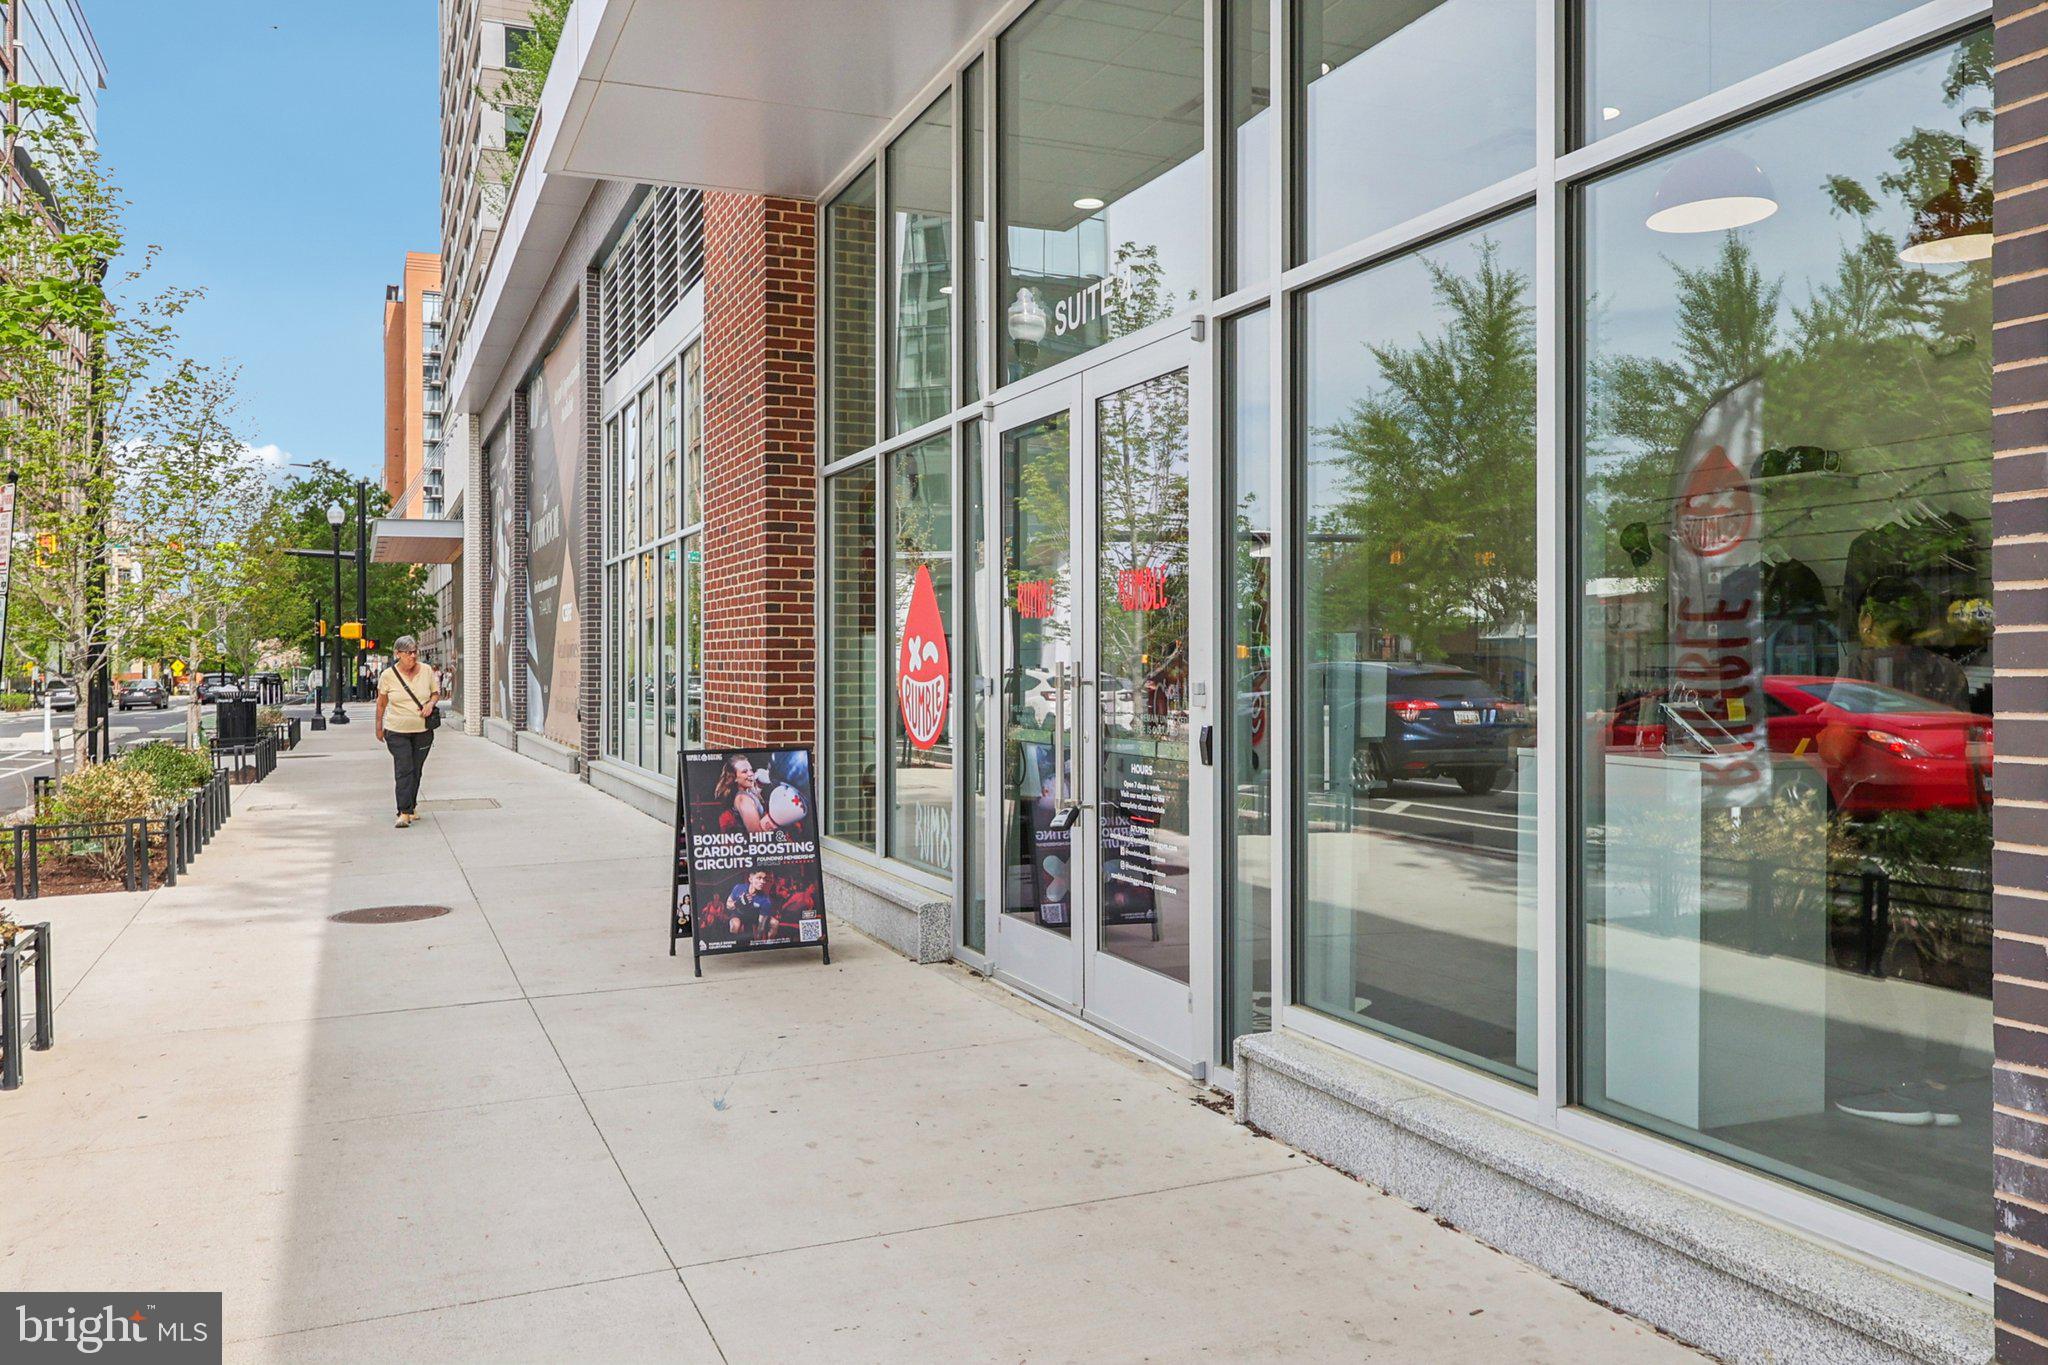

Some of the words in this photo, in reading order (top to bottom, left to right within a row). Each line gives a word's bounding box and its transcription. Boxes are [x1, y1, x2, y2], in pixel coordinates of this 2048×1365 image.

[1054, 275, 1115, 337] SUITE
[1017, 577, 1055, 619] RUMBLE
[1117, 563, 1168, 612] RUMBLE
[905, 680, 942, 737] RUMBLE
[1123, 780, 1134, 789] Open
[1131, 763, 1153, 776] HOURS
[693, 832, 748, 846] BOXING,
[749, 831, 774, 843] HIIT
[775, 830, 788, 842] &
[915, 799, 951, 870] RUMB
[693, 841, 815, 859] CARDIO-BOOSTING
[694, 857, 753, 871] CIRCUITS
